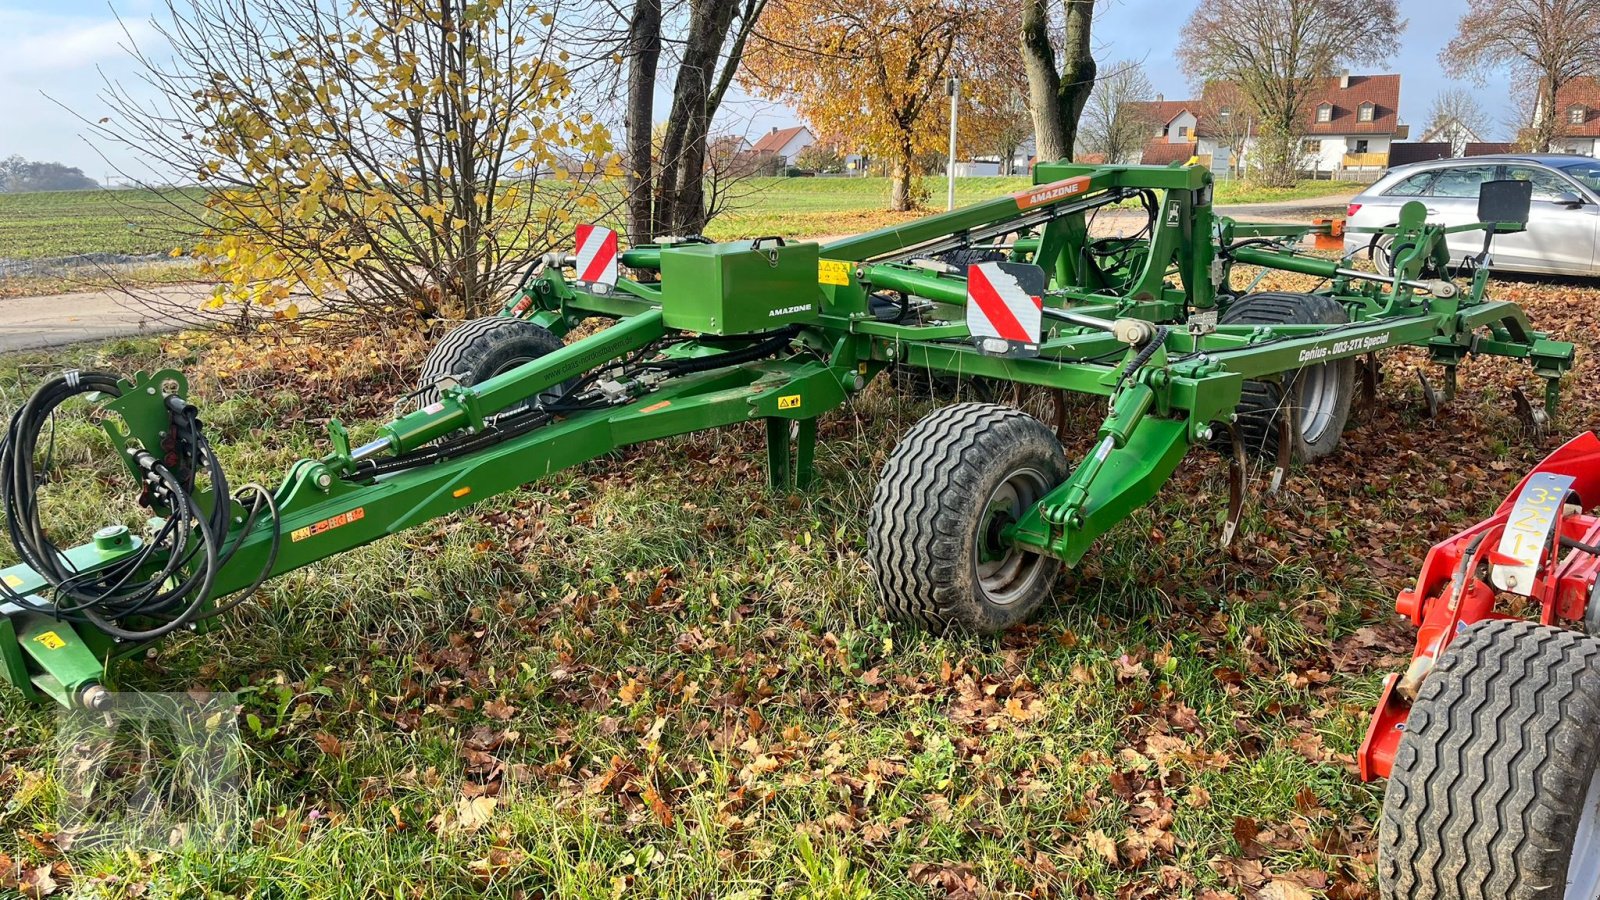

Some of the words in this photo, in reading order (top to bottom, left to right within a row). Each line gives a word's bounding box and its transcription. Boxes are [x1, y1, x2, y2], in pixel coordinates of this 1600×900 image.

[1030, 184, 1079, 204] AMAZONE
[769, 304, 812, 317] AMAZONE
[1299, 345, 1327, 362] Cenius
[1363, 332, 1389, 350] Special
[1526, 488, 1548, 505] 3
[1515, 509, 1539, 528] 2
[1513, 533, 1524, 555] 1
